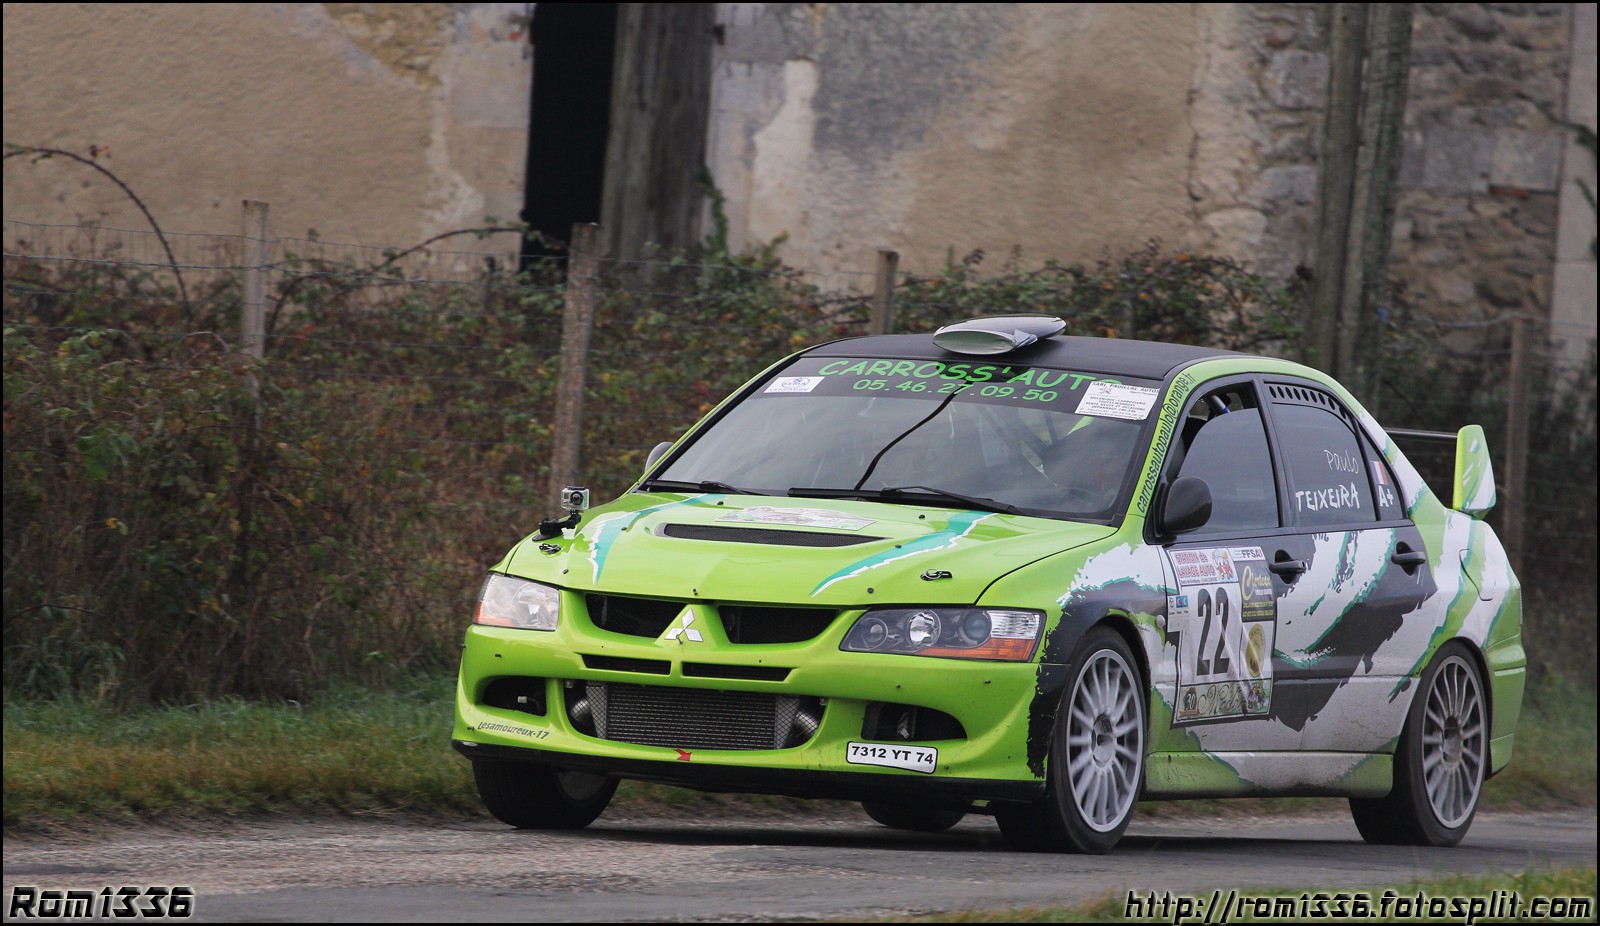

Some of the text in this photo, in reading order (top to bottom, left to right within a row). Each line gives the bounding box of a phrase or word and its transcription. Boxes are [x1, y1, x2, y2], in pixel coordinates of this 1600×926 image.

[1136, 372, 1196, 514] carrossautopaulo@orange.fr
[1295, 482, 1360, 512] TEIXEIRA
[1378, 485, 1394, 507] A+
[1197, 587, 1230, 676] 22
[478, 721, 550, 739] Lesamoureux-17
[852, 746, 934, 765] 7312 YT 74
